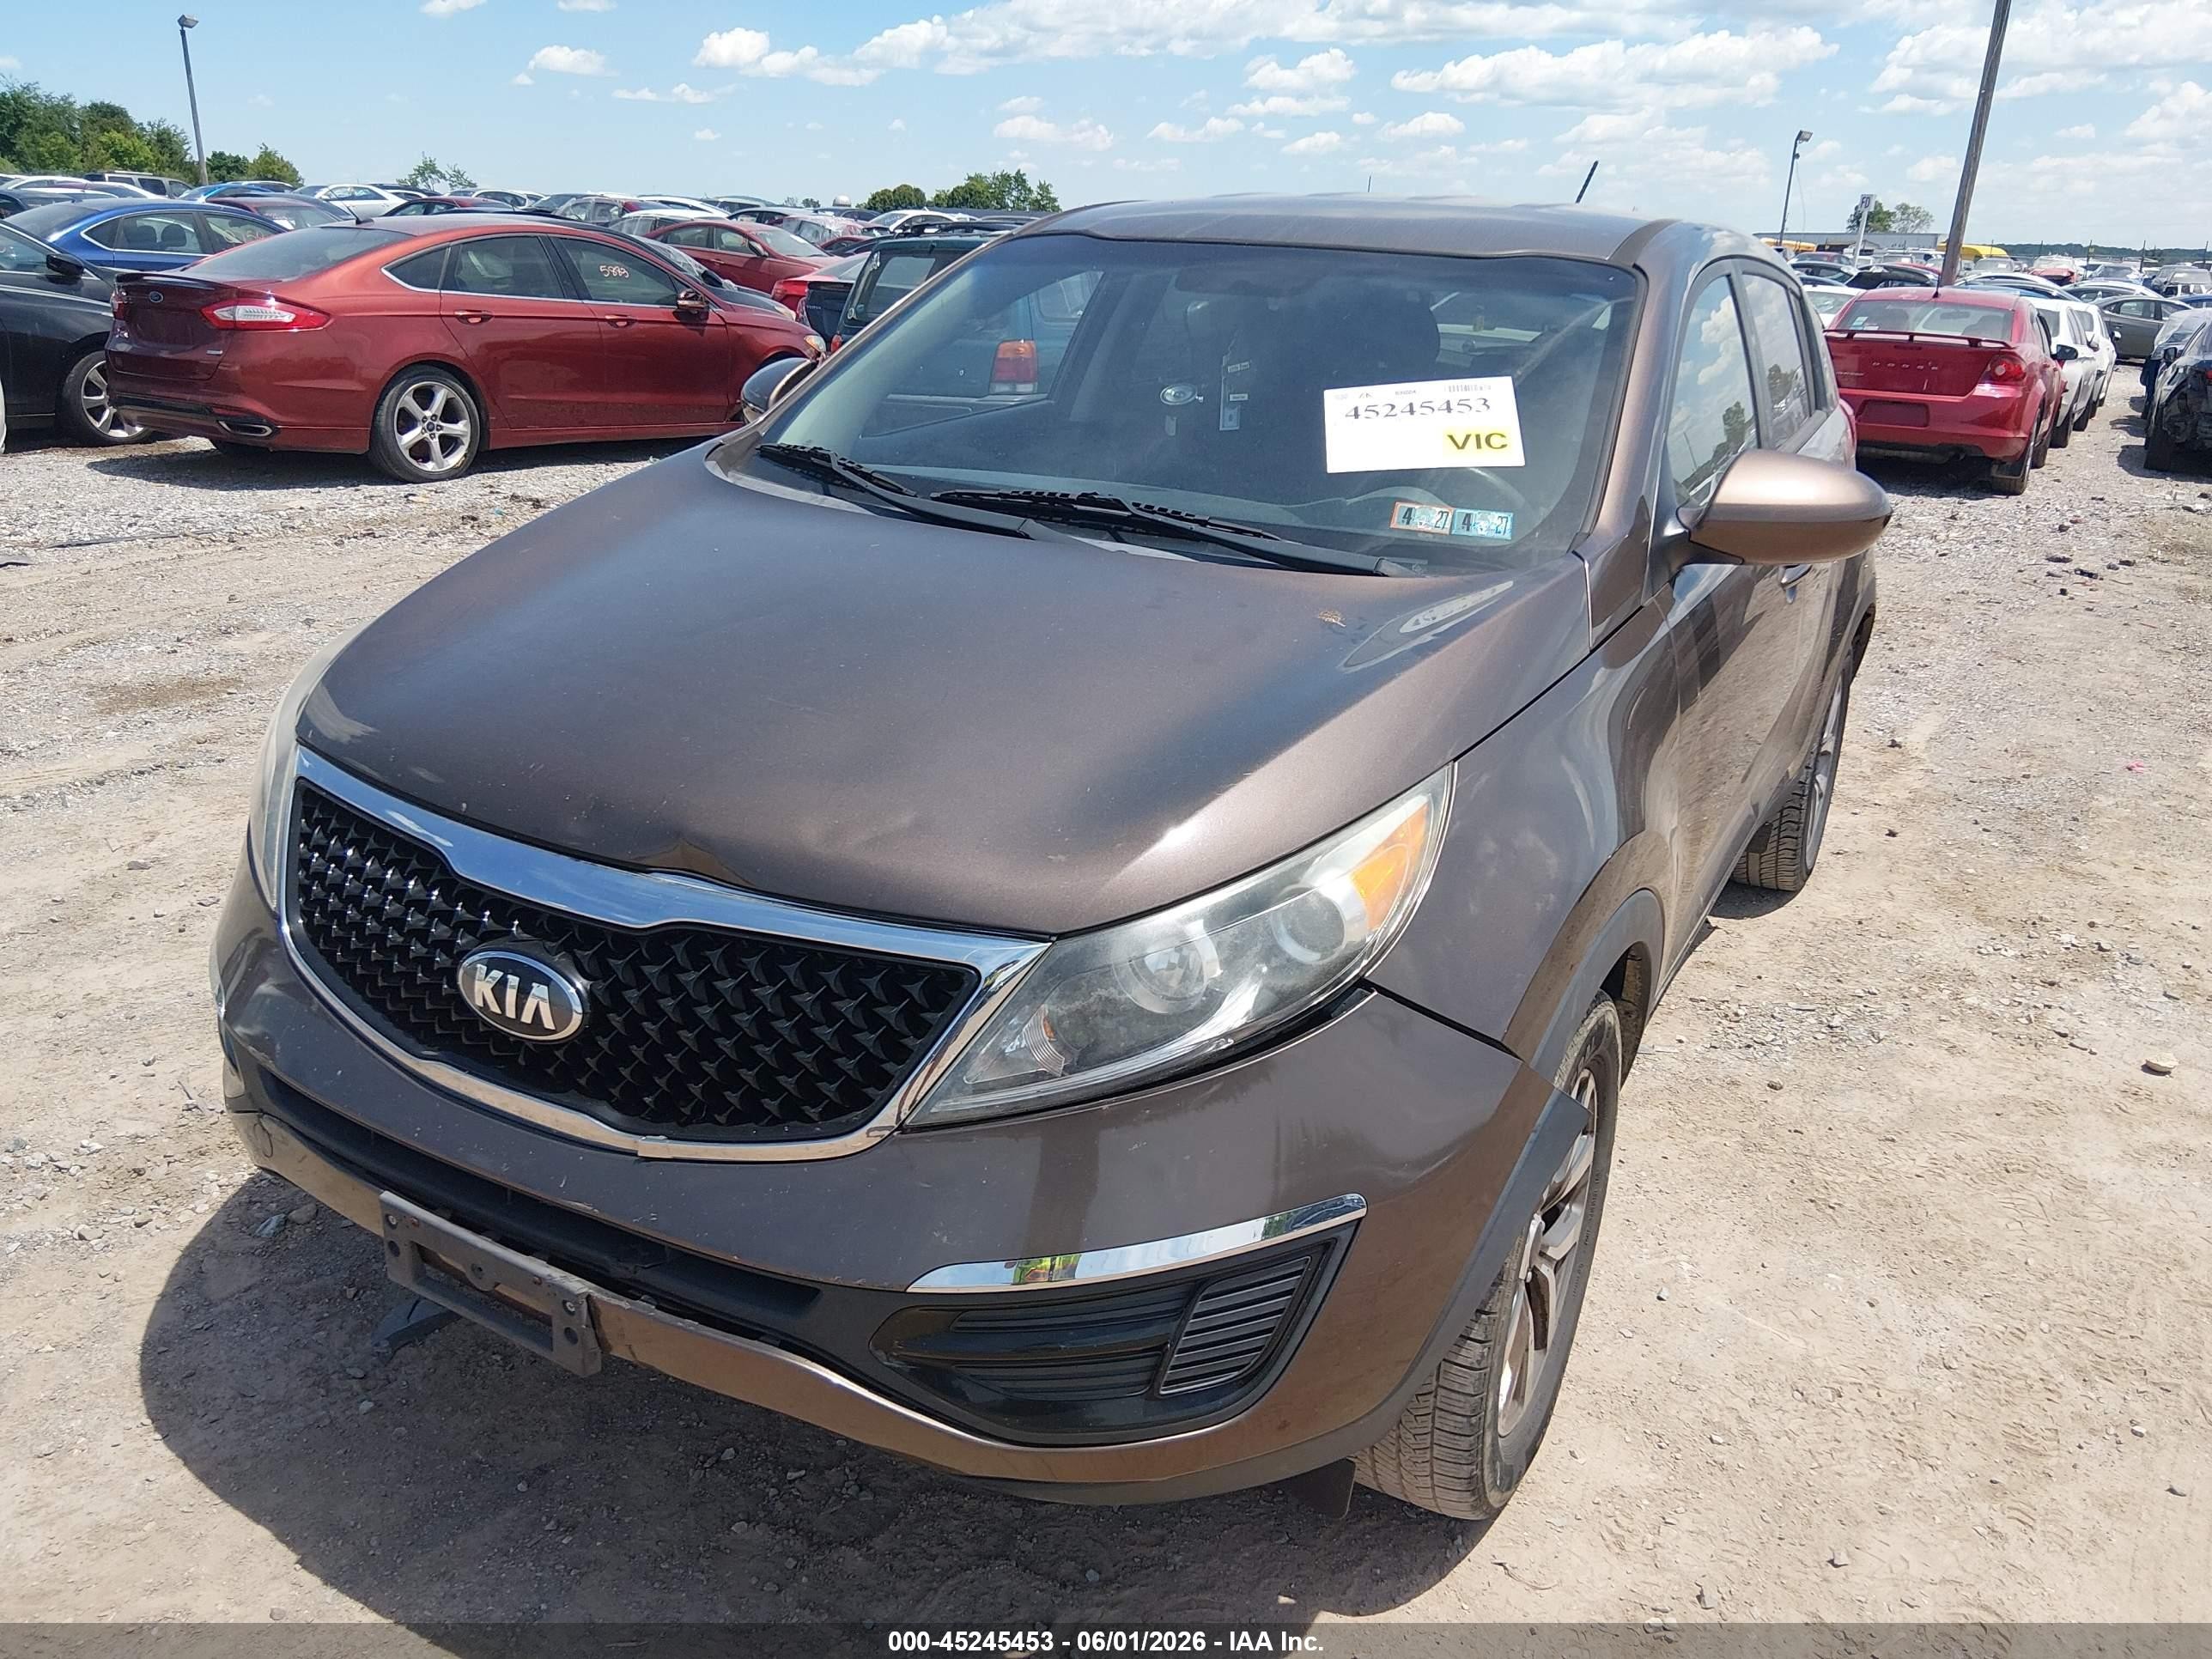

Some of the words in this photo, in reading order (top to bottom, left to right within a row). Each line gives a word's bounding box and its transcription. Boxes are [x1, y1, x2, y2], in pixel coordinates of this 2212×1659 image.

[1345, 397, 1492, 420] 45245453
[1447, 432, 1509, 450] VIC
[1401, 507, 1414, 526] 4
[1434, 510, 1449, 530] 27
[1462, 513, 1473, 532] 4
[1495, 515, 1509, 536] 27
[474, 963, 556, 1030] KIA
